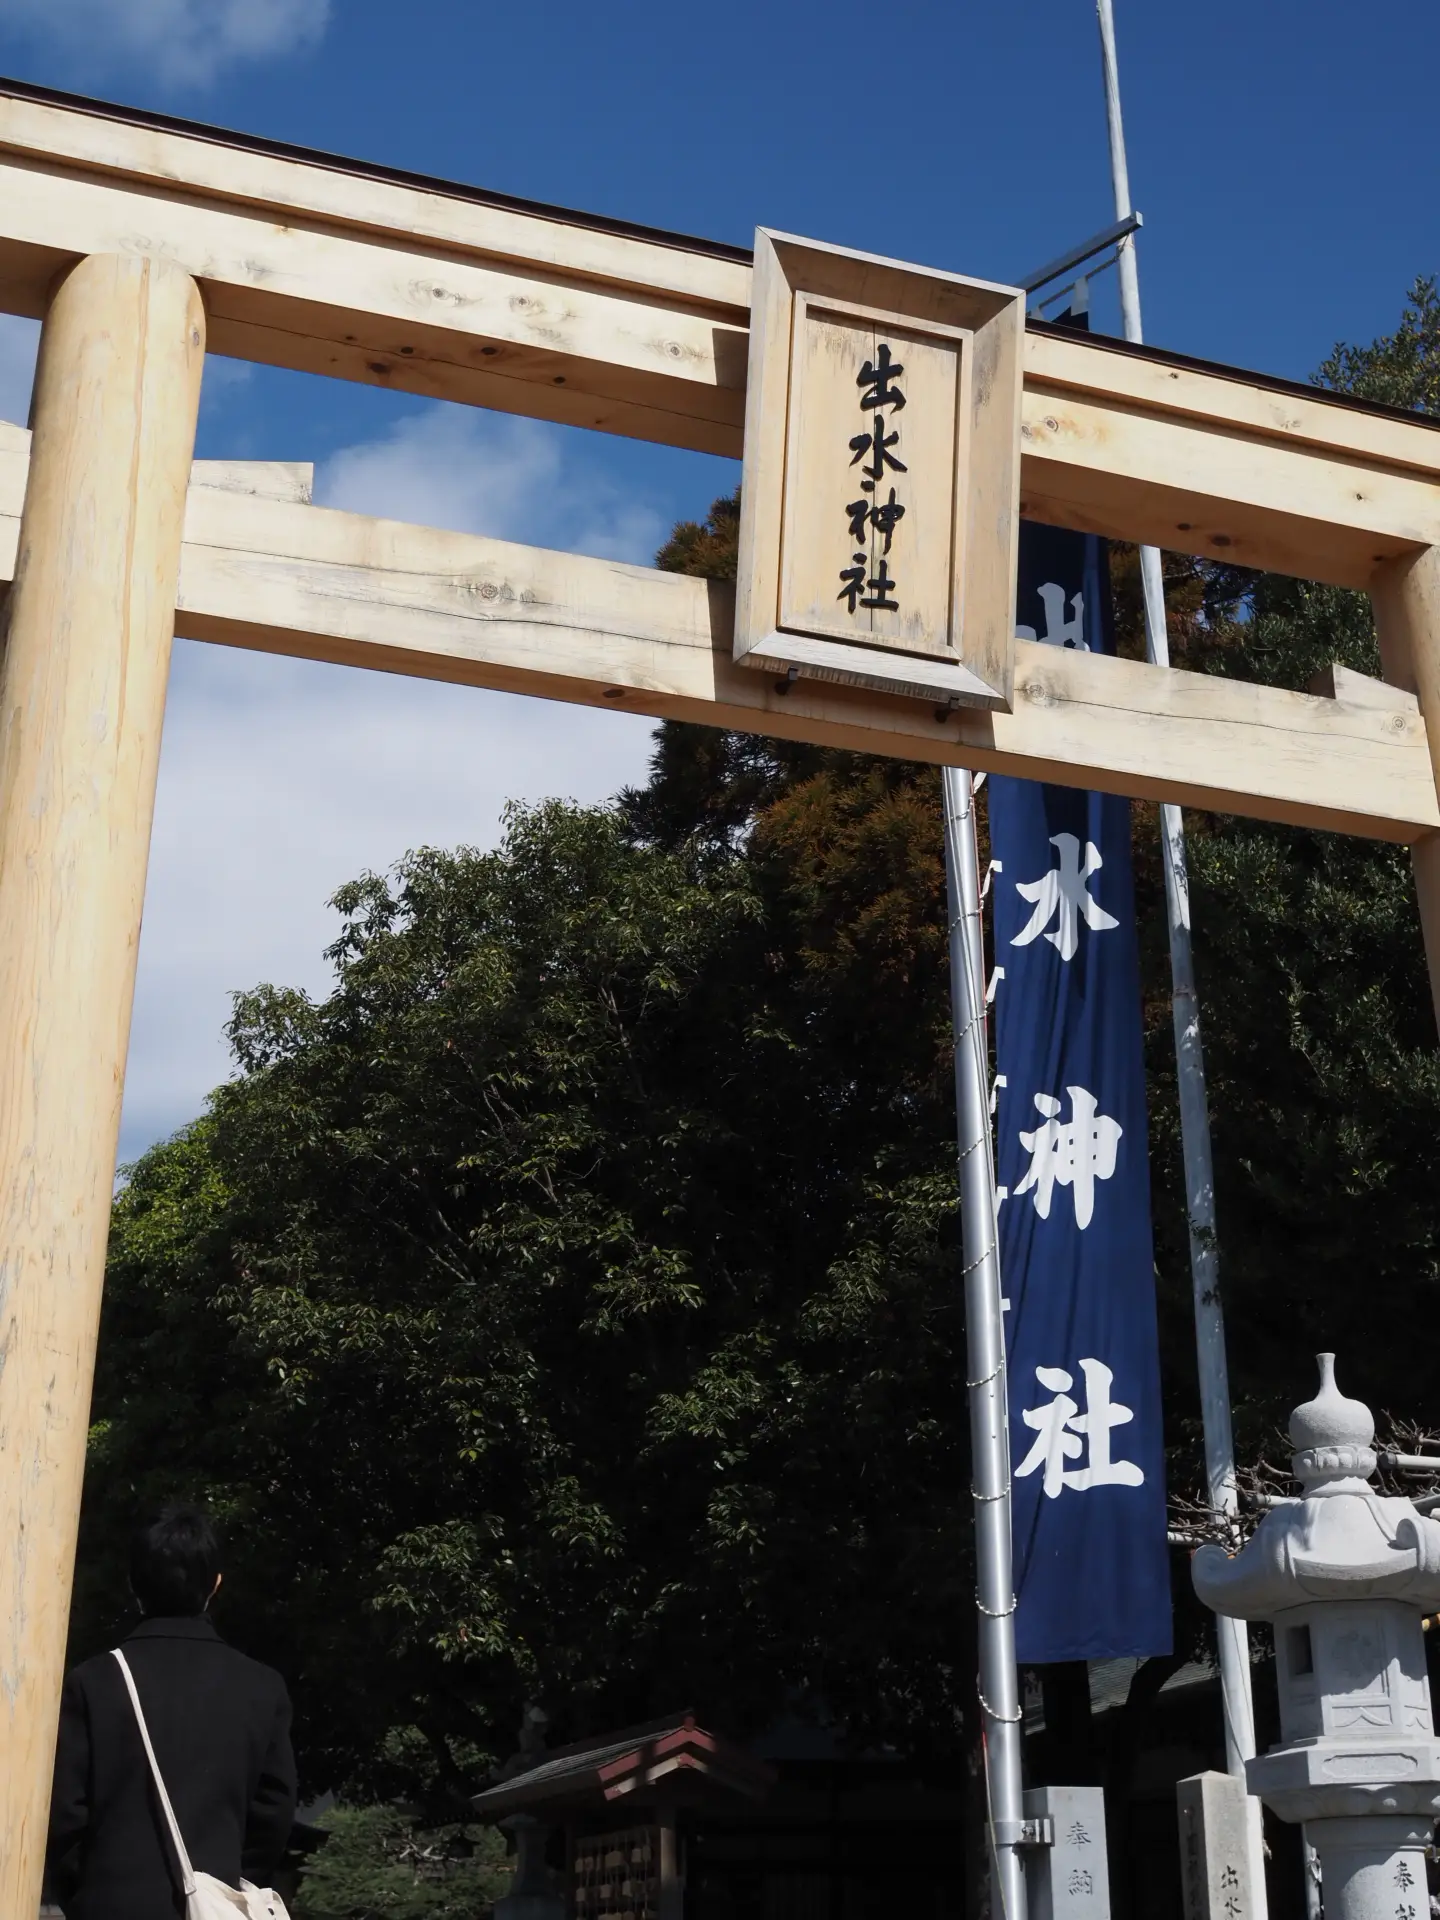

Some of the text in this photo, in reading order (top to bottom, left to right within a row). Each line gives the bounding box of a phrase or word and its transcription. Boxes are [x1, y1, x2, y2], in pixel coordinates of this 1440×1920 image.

[837, 344, 908, 614] 出水神社
[1066, 1821, 1093, 1896] 奉納
